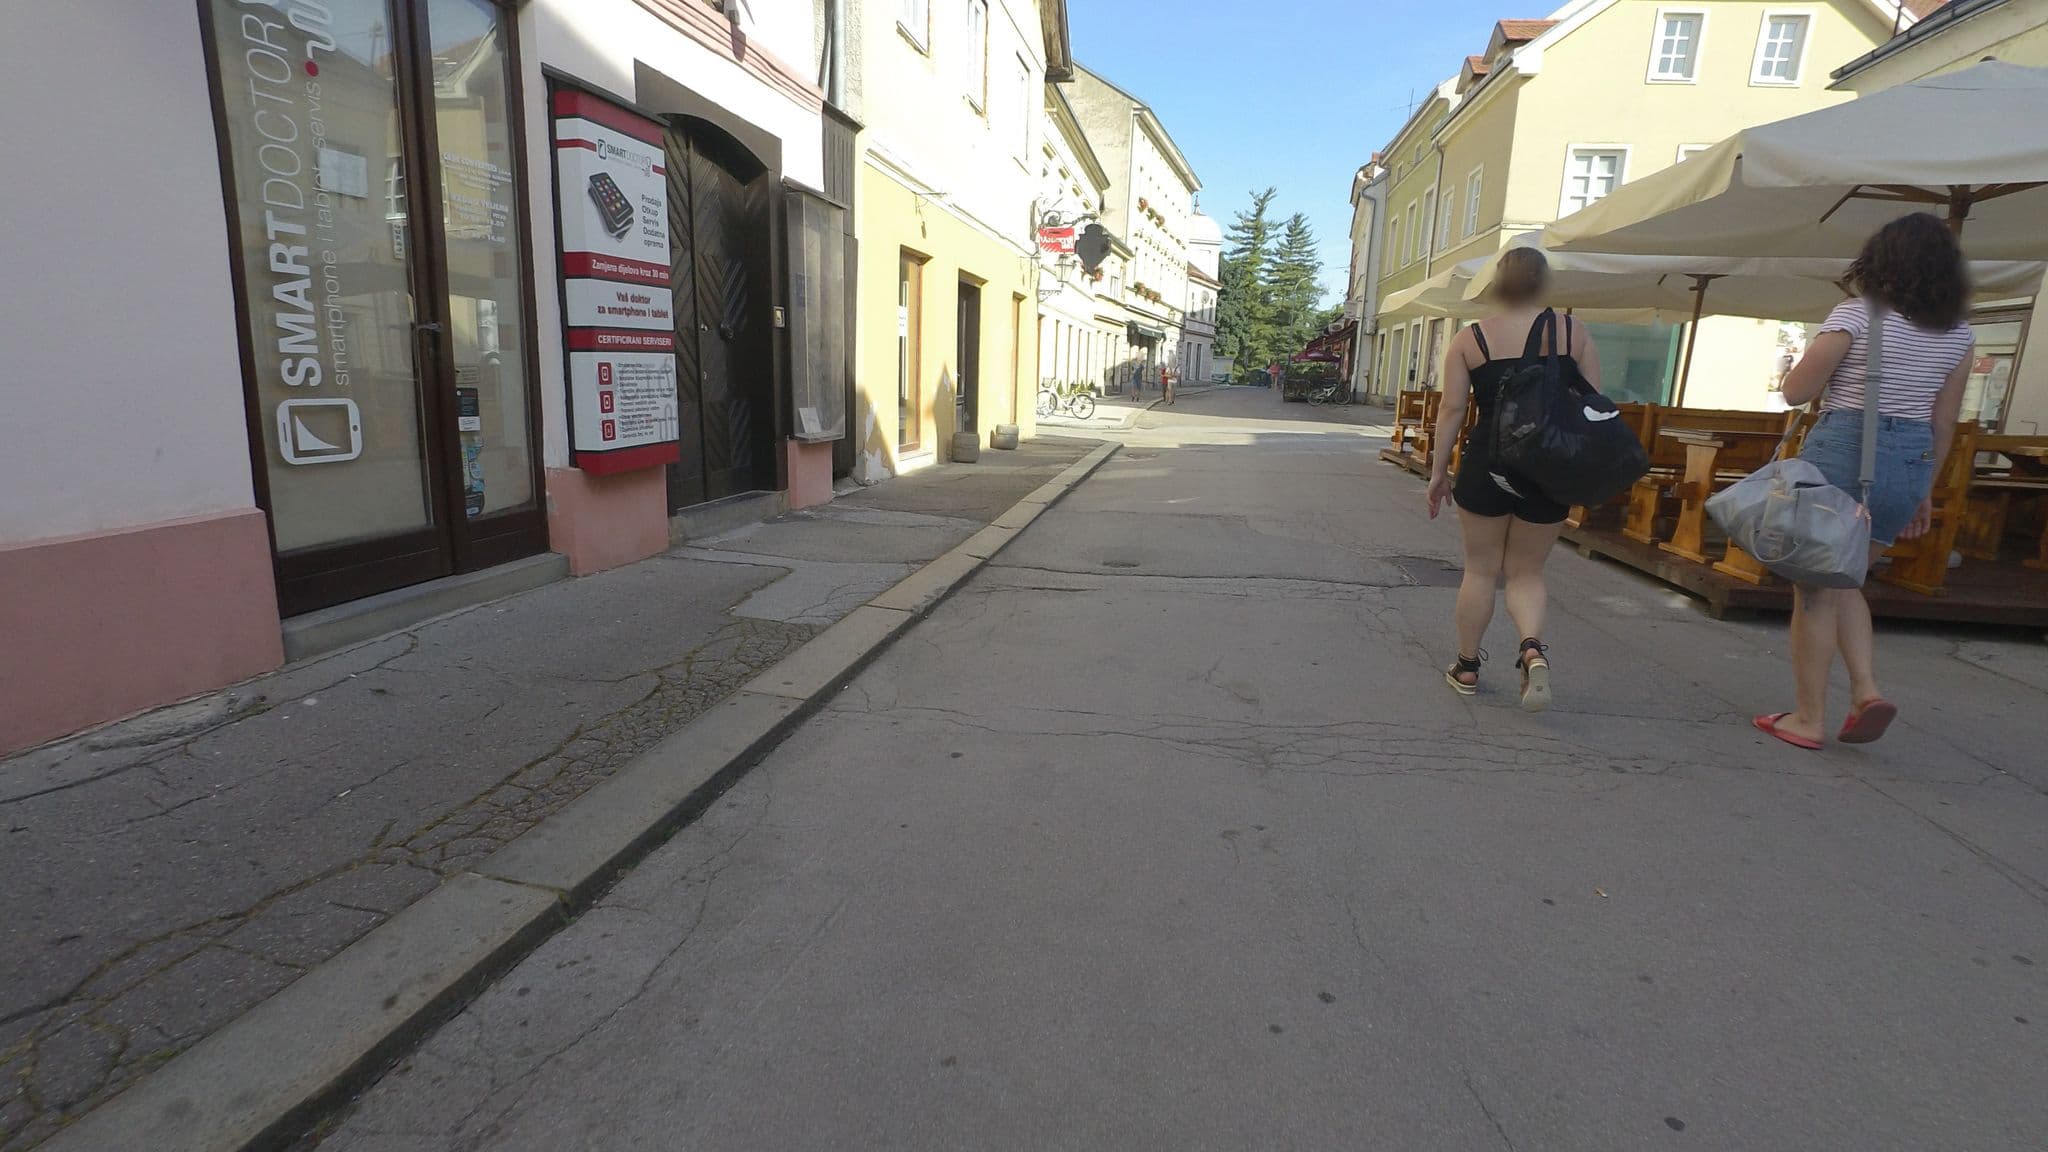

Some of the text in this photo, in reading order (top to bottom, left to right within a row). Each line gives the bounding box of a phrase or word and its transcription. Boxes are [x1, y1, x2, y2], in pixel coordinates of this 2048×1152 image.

[305, 81, 329, 148] servis
[241, 13, 322, 387] SMARTDOCTOR
[641, 194, 662, 208] Prodaja
[642, 216, 659, 227] Servis
[644, 239, 664, 249] oprema
[592, 259, 618, 274] Zamjena
[631, 293, 651, 304] doktor
[321, 249, 350, 386] smartphone
[597, 305, 606, 314] za
[608, 306, 646, 318] smartphone
[651, 309, 669, 319] tablet
[597, 334, 671, 346] CERTIFICIRANI SERVISERI
